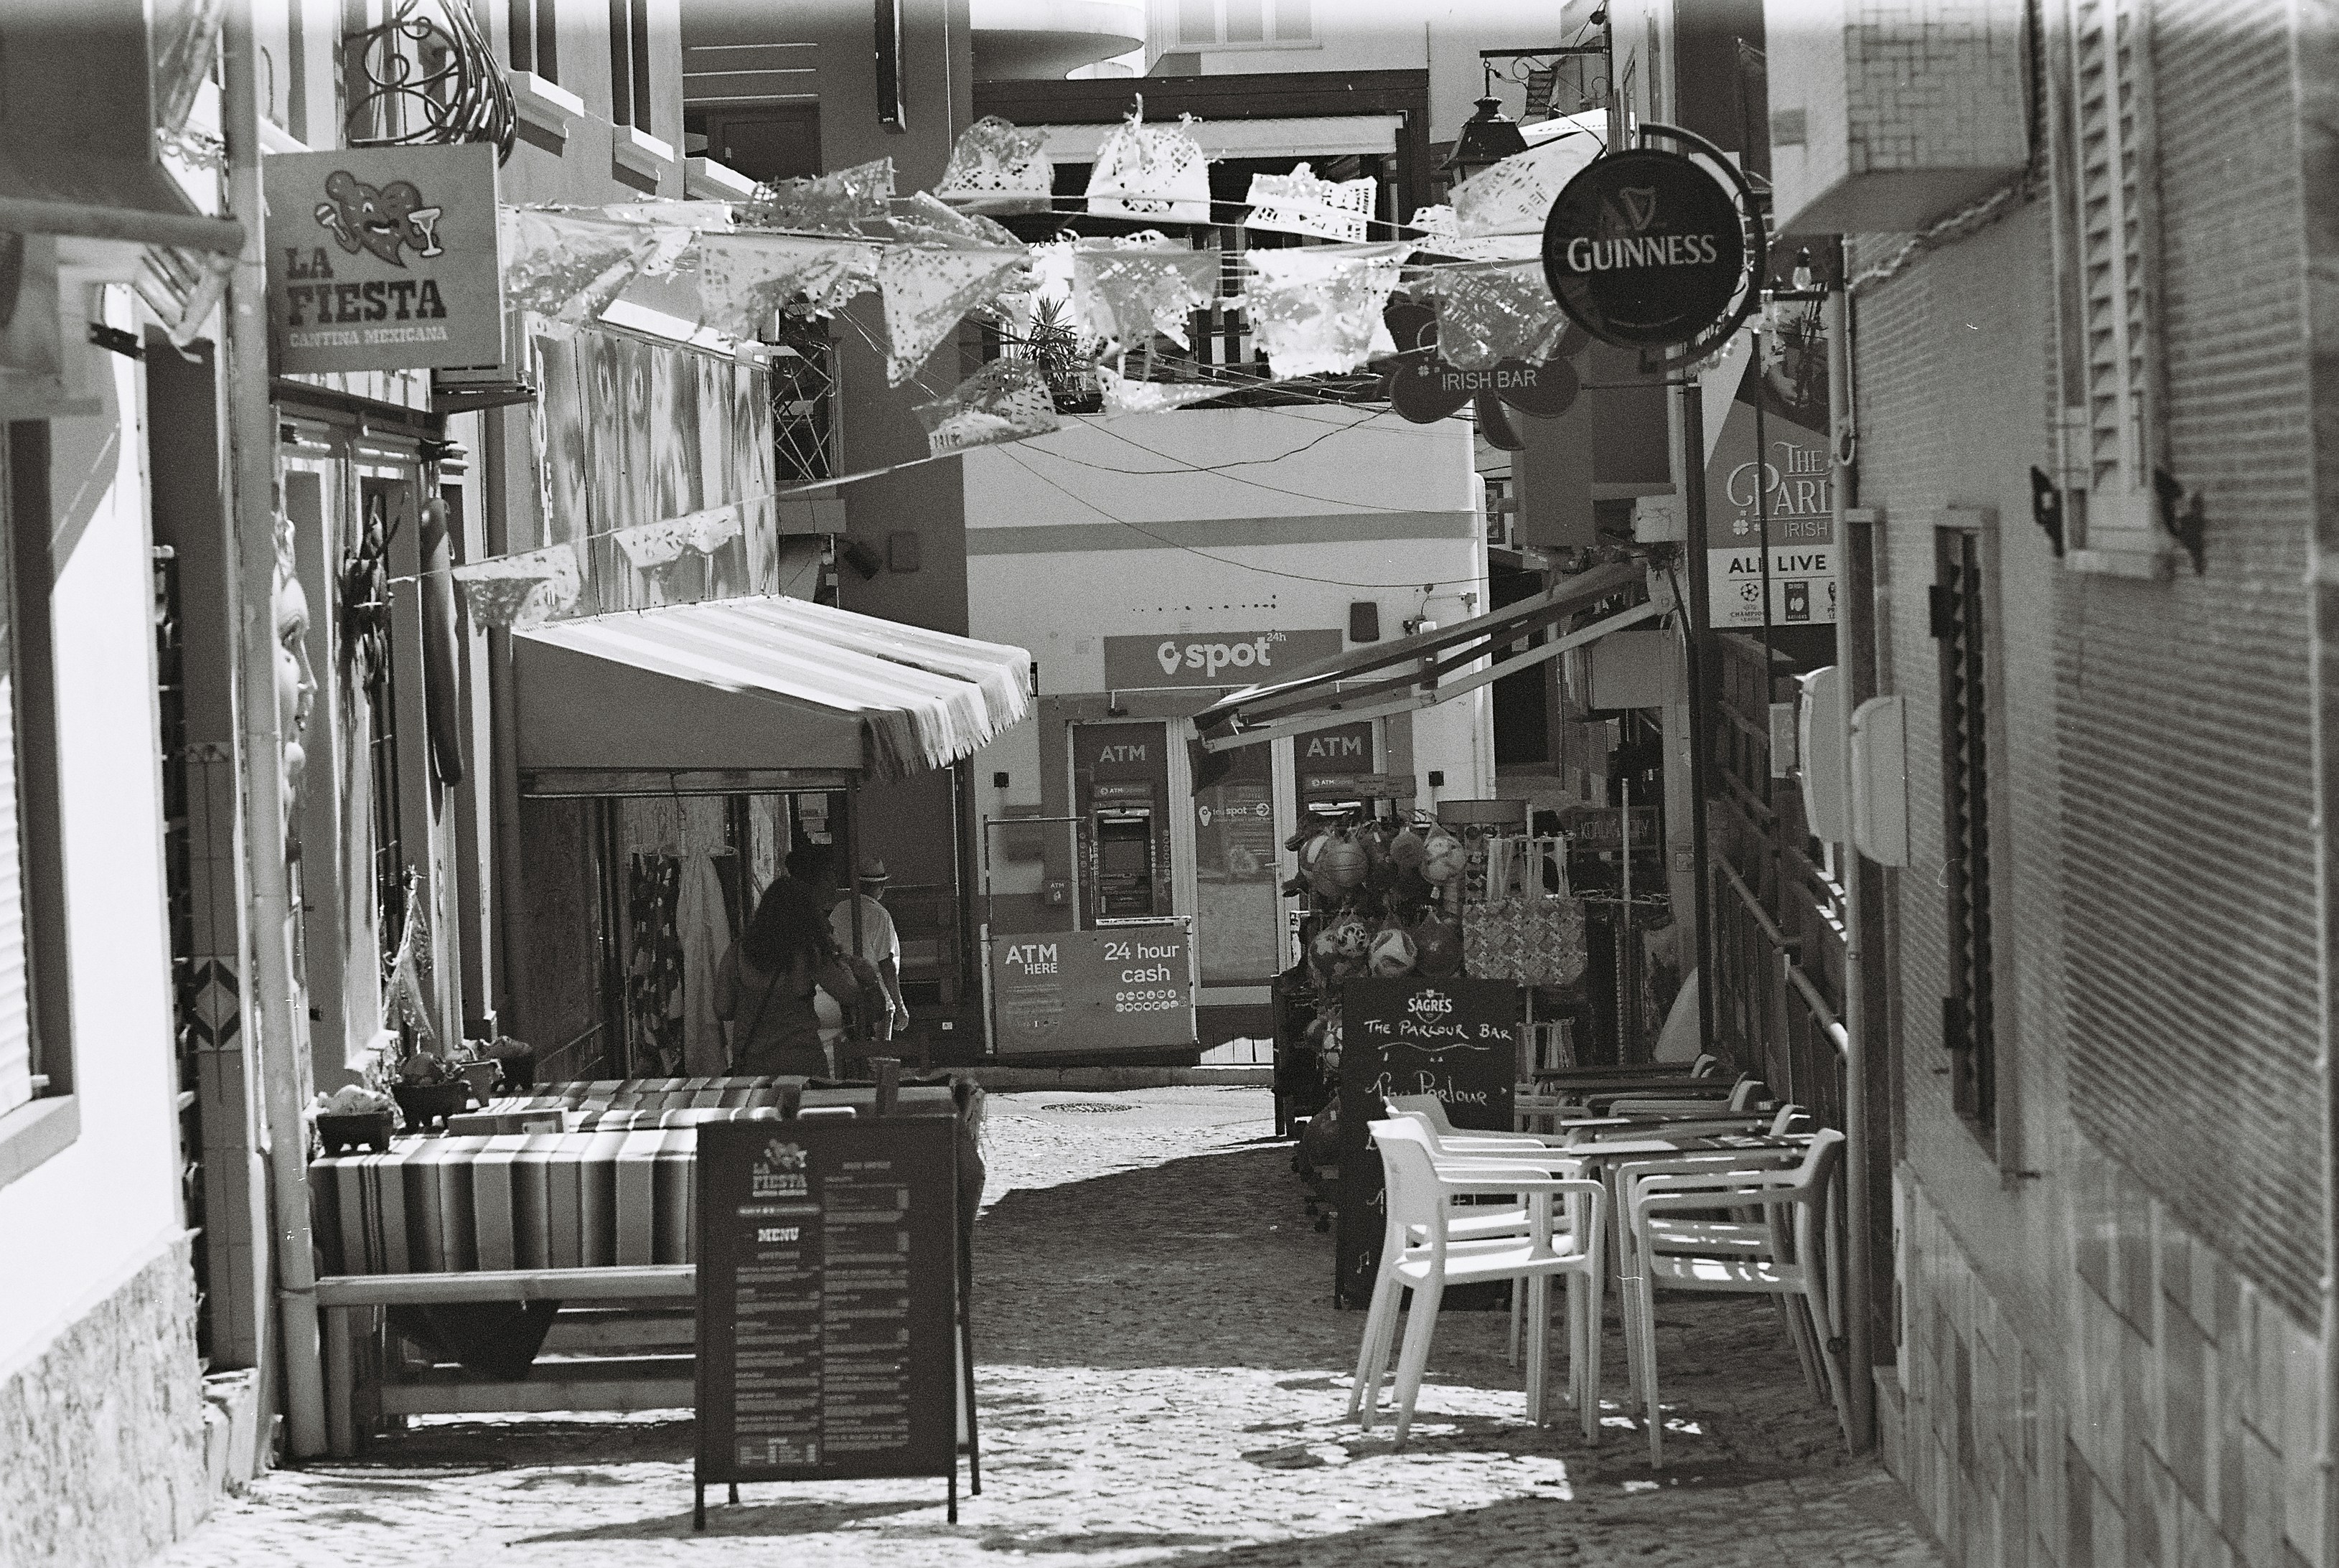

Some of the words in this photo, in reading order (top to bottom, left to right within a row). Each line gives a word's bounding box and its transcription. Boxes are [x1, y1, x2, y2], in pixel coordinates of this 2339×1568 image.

[284, 246, 334, 280] LA
[1567, 234, 1717, 272] GUINNESS
[287, 279, 448, 327] FIESTA
[289, 330, 360, 347] CANTINA
[364, 325, 449, 344] MEXICANA
[1442, 371, 1492, 391] IRISH
[1497, 369, 1537, 388] BAR
[1772, 441, 1824, 474] THE
[1784, 521, 1829, 538] IRISH
[1777, 554, 1827, 572] LIVE
[1185, 636, 1271, 677] spot
[1266, 632, 1287, 642] 24h
[1099, 744, 1146, 763] ATM
[1306, 736, 1362, 757] ATM
[1226, 806, 1247, 817] spot
[1005, 943, 1058, 964] ATM
[1104, 942, 1131, 961] 24
[1137, 942, 1181, 959] hour
[1024, 962, 1059, 975] HERE
[1121, 964, 1171, 983] cash
[1407, 997, 1453, 1013] SAGRES
[1364, 1019, 1391, 1034] THE
[1399, 1019, 1470, 1040] PARLOUR
[1479, 1023, 1514, 1041] BAR
[758, 1227, 800, 1242] MENU
